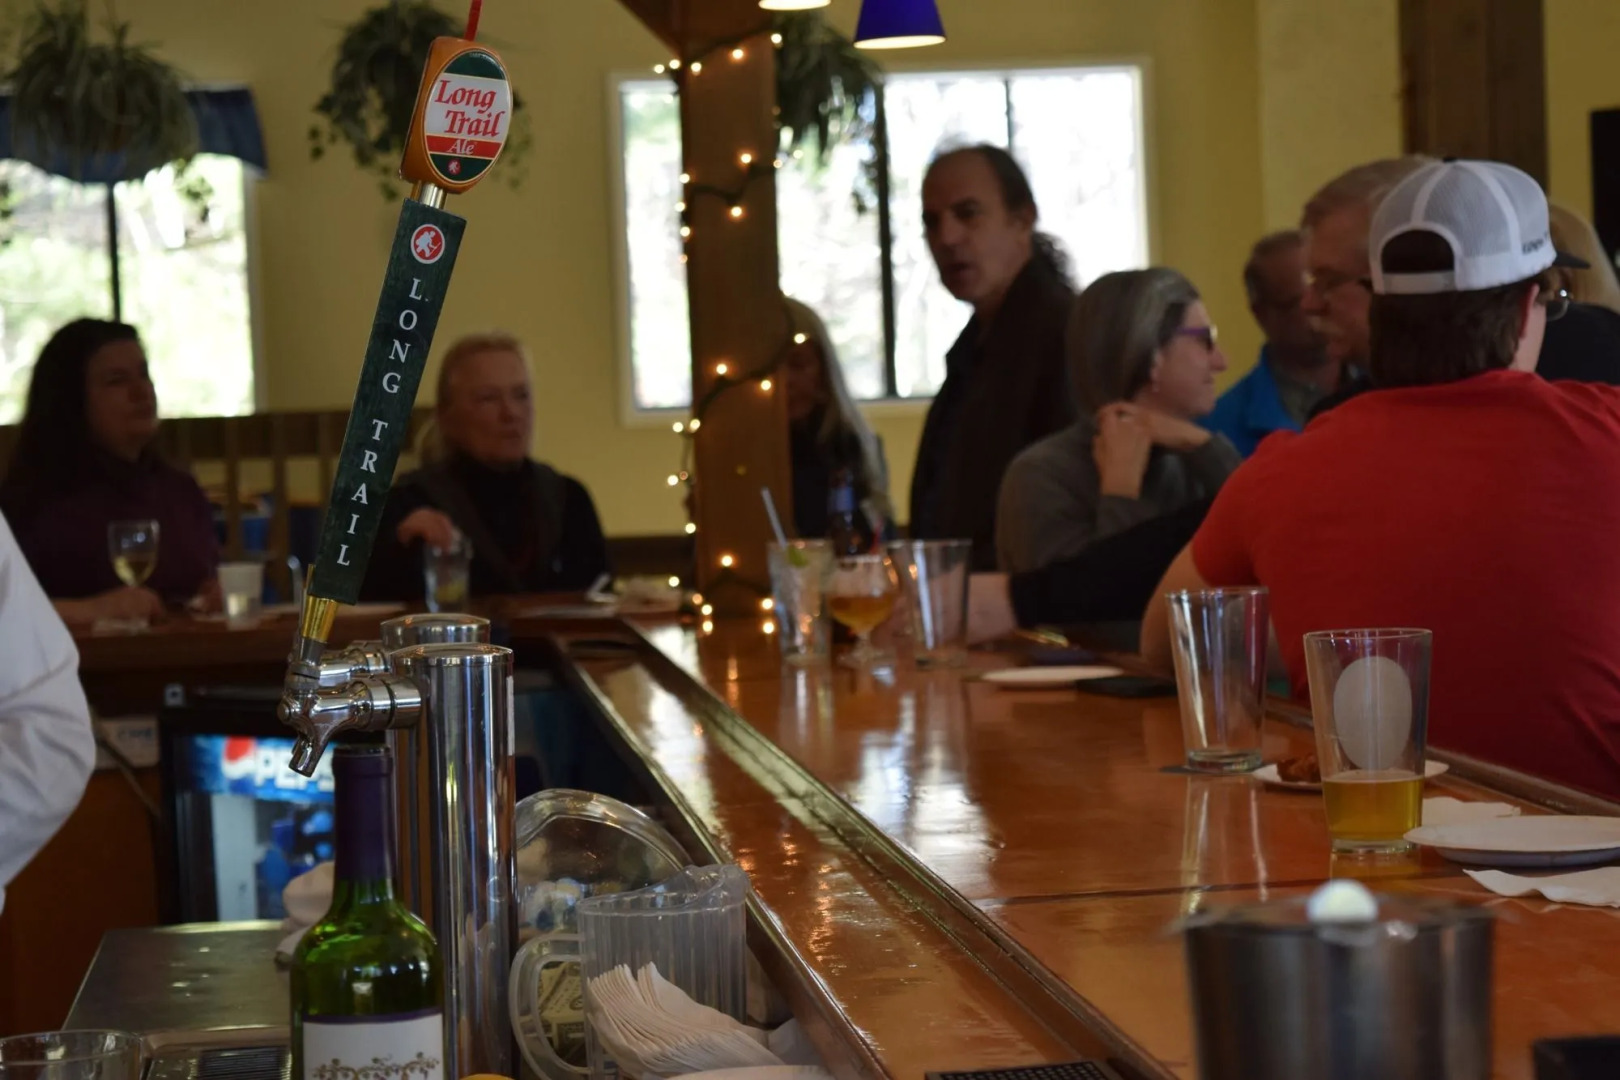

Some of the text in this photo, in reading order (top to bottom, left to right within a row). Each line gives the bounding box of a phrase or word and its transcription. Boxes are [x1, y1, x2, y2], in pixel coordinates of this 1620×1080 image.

[434, 79, 497, 114] Long
[444, 109, 506, 137] Trail
[446, 138, 475, 155] Ale
[337, 277, 422, 566] LONG TRAIL
